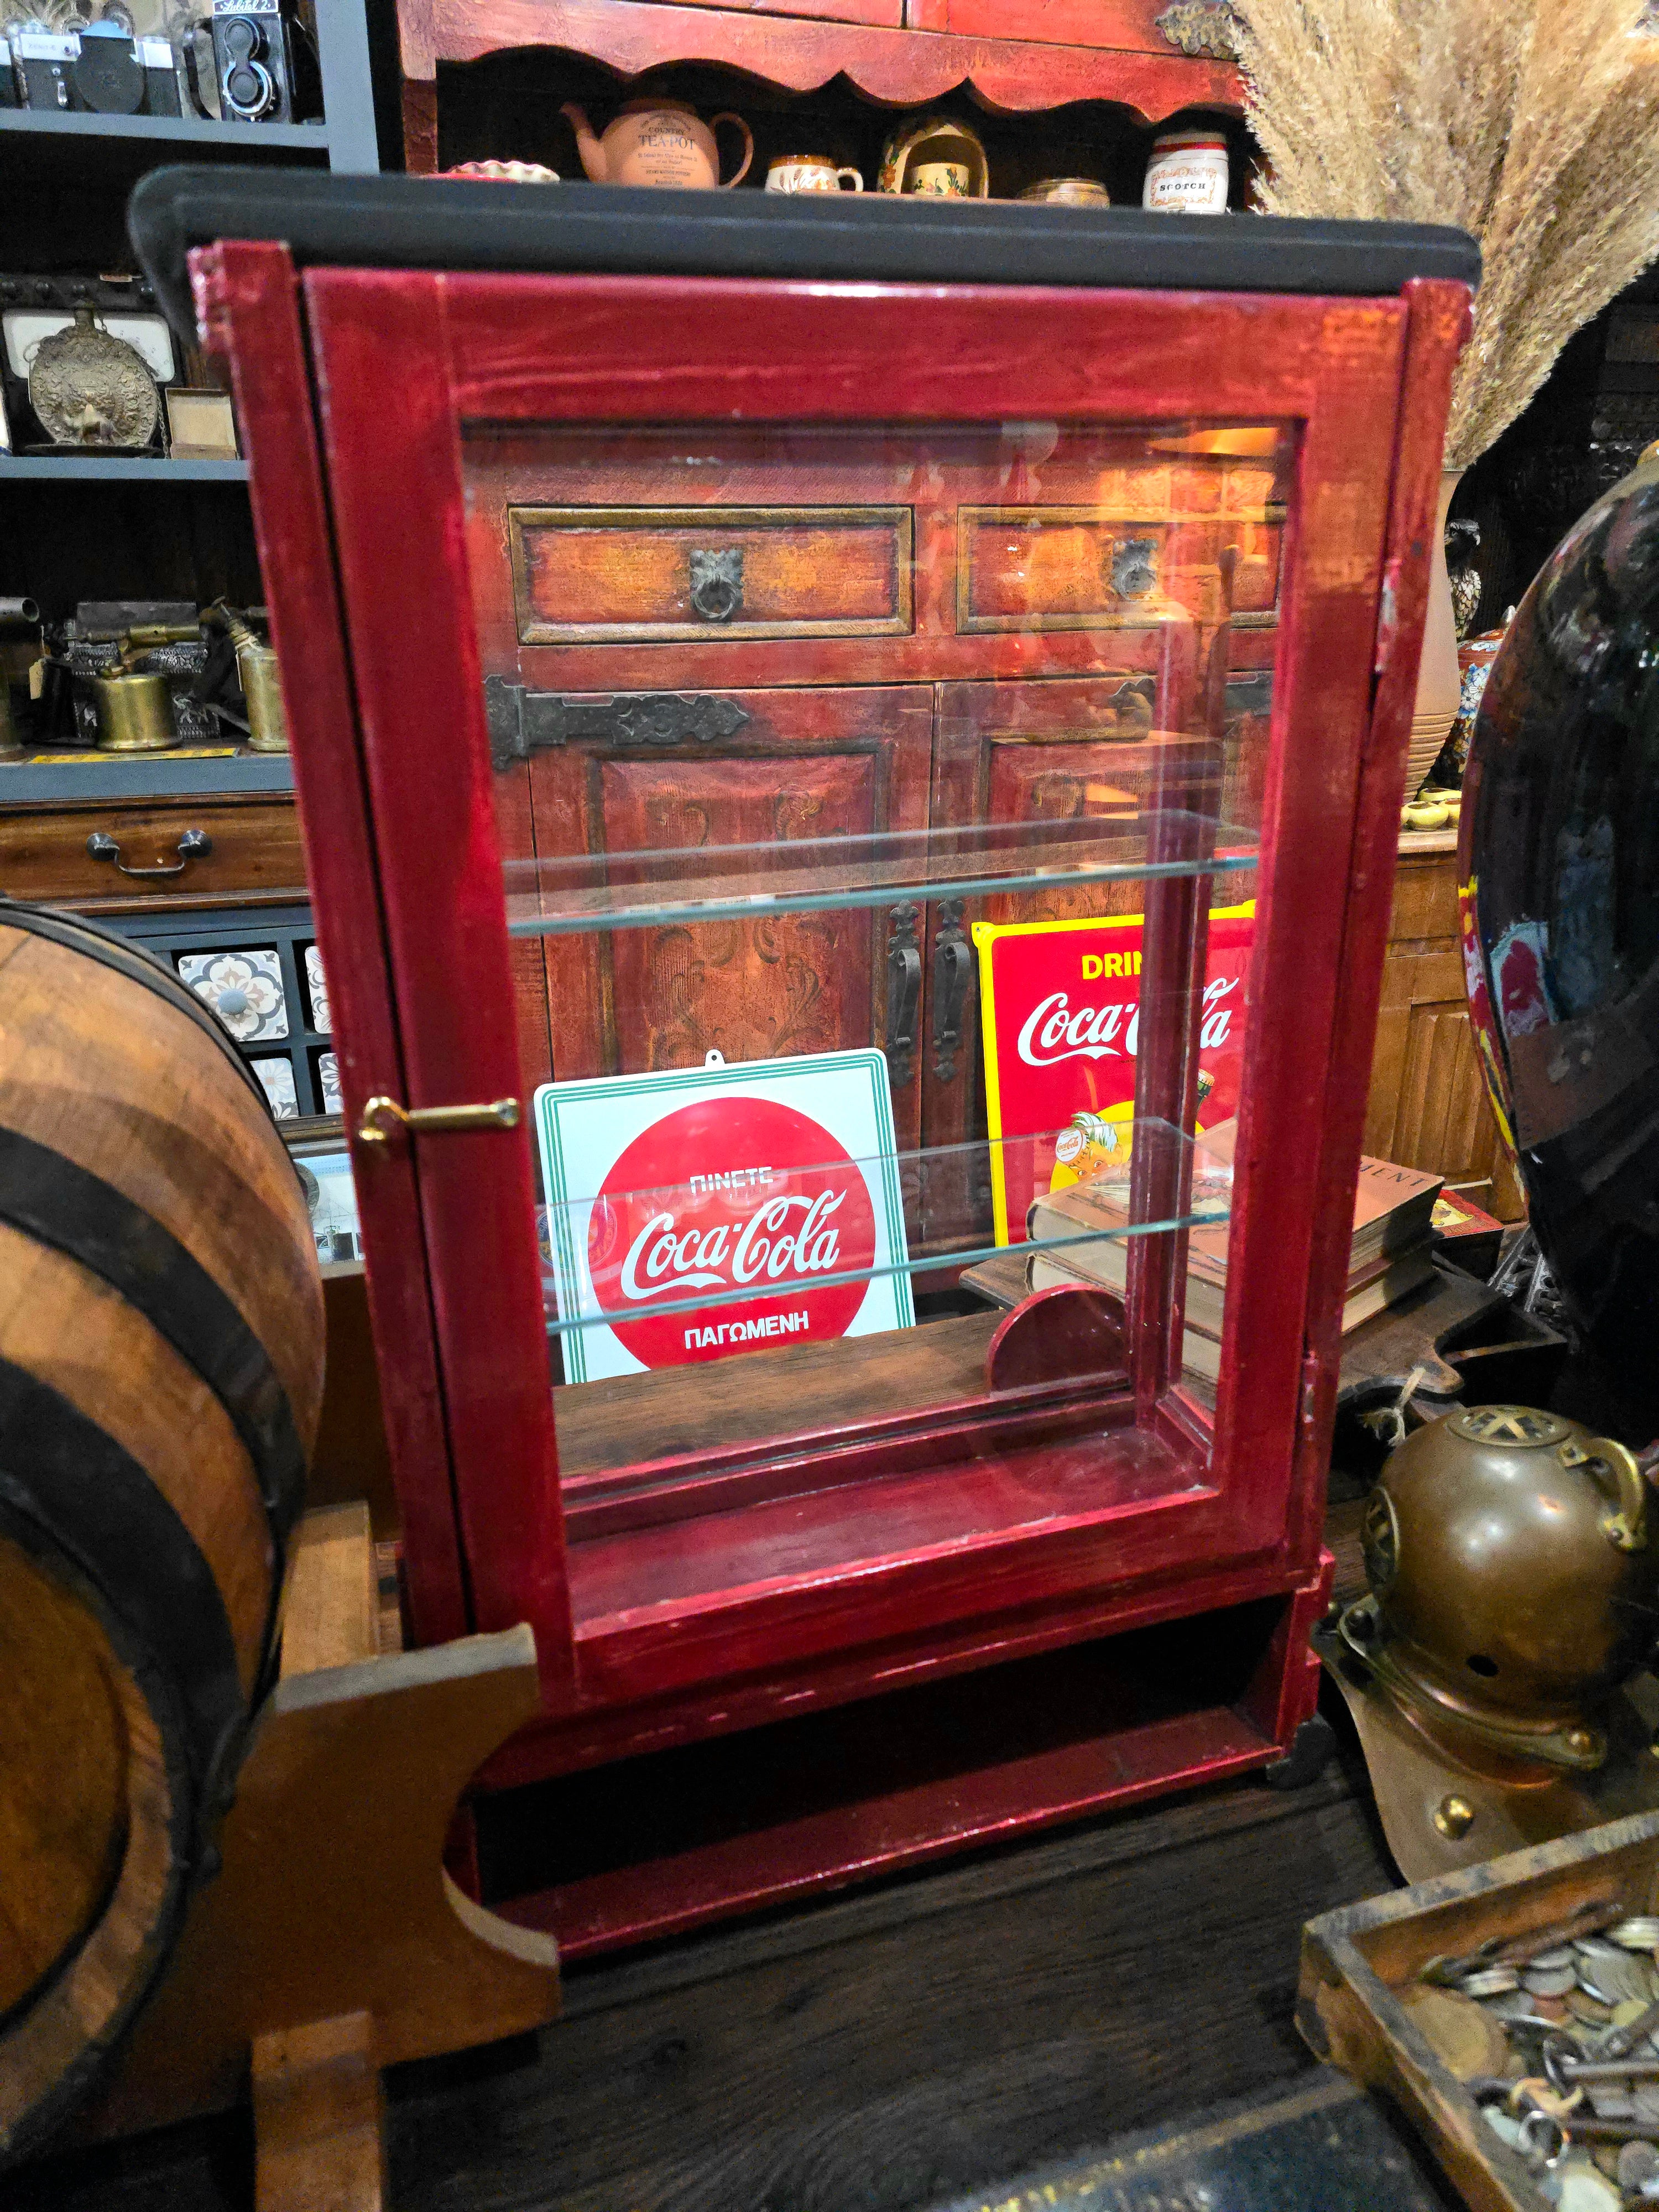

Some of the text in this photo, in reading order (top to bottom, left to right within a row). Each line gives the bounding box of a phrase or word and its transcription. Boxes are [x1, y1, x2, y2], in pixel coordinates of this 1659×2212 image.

[260, 0, 268, 11] 2
[648, 127, 685, 135] COUNTRY
[1160, 183, 1206, 192] SCOTCH
[690, 1166, 774, 1193] ΠΙΝΕΤΕ
[620, 1189, 847, 1300] Coca-Cola
[684, 1310, 809, 1349] ΠΑΓΩΜΕΝΗ
